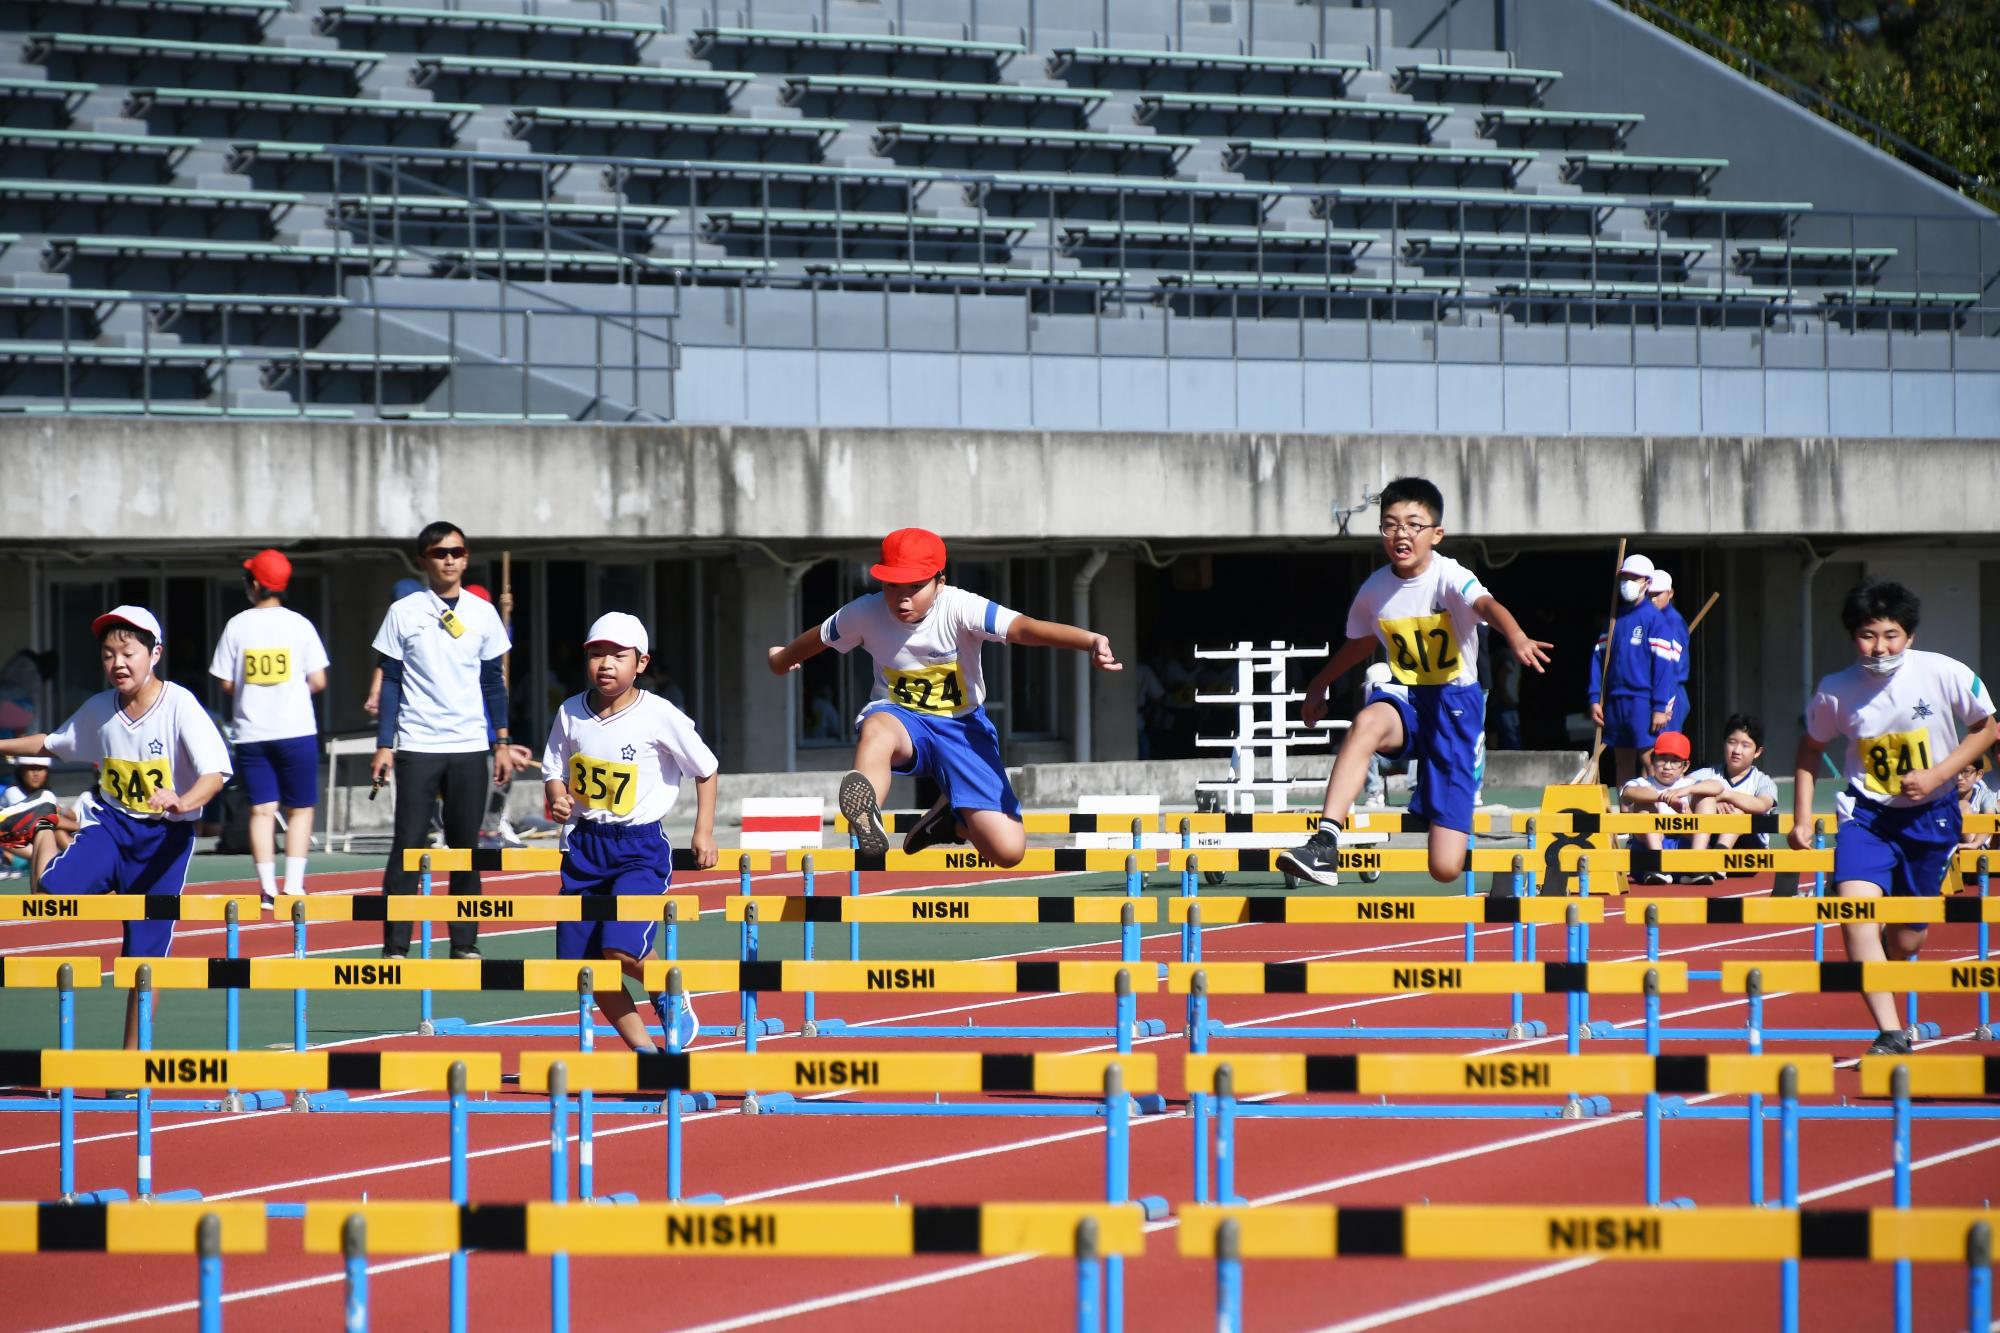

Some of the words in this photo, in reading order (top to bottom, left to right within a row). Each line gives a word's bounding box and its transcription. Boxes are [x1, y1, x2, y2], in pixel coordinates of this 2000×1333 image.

[1392, 629, 1458, 672] 812
[246, 653, 287, 676] 309
[894, 671, 962, 709] 424
[1870, 741, 1929, 781] 841
[575, 763, 631, 804] 357
[1654, 817, 1699, 831] NISHI
[1198, 838, 1222, 846] NISHI
[946, 853, 995, 868] NISH
[1724, 853, 1775, 869] NISHI
[22, 900, 78, 917] NISHI
[457, 900, 514, 917] NISHI
[912, 901, 969, 918] NISHI
[1357, 902, 1415, 919] NISHI
[1816, 901, 1875, 919] NISHI
[334, 965, 401, 986] NISHI
[867, 968, 935, 989] NISHI
[1393, 968, 1461, 989] NISHI
[1951, 967, 2000, 988] NIS
[145, 1058, 228, 1085] NISHI
[795, 1060, 879, 1086] NISHI
[1465, 1062, 1549, 1088] NISHI
[666, 1214, 776, 1246] NISHI
[1549, 1218, 1660, 1250] NISHI
